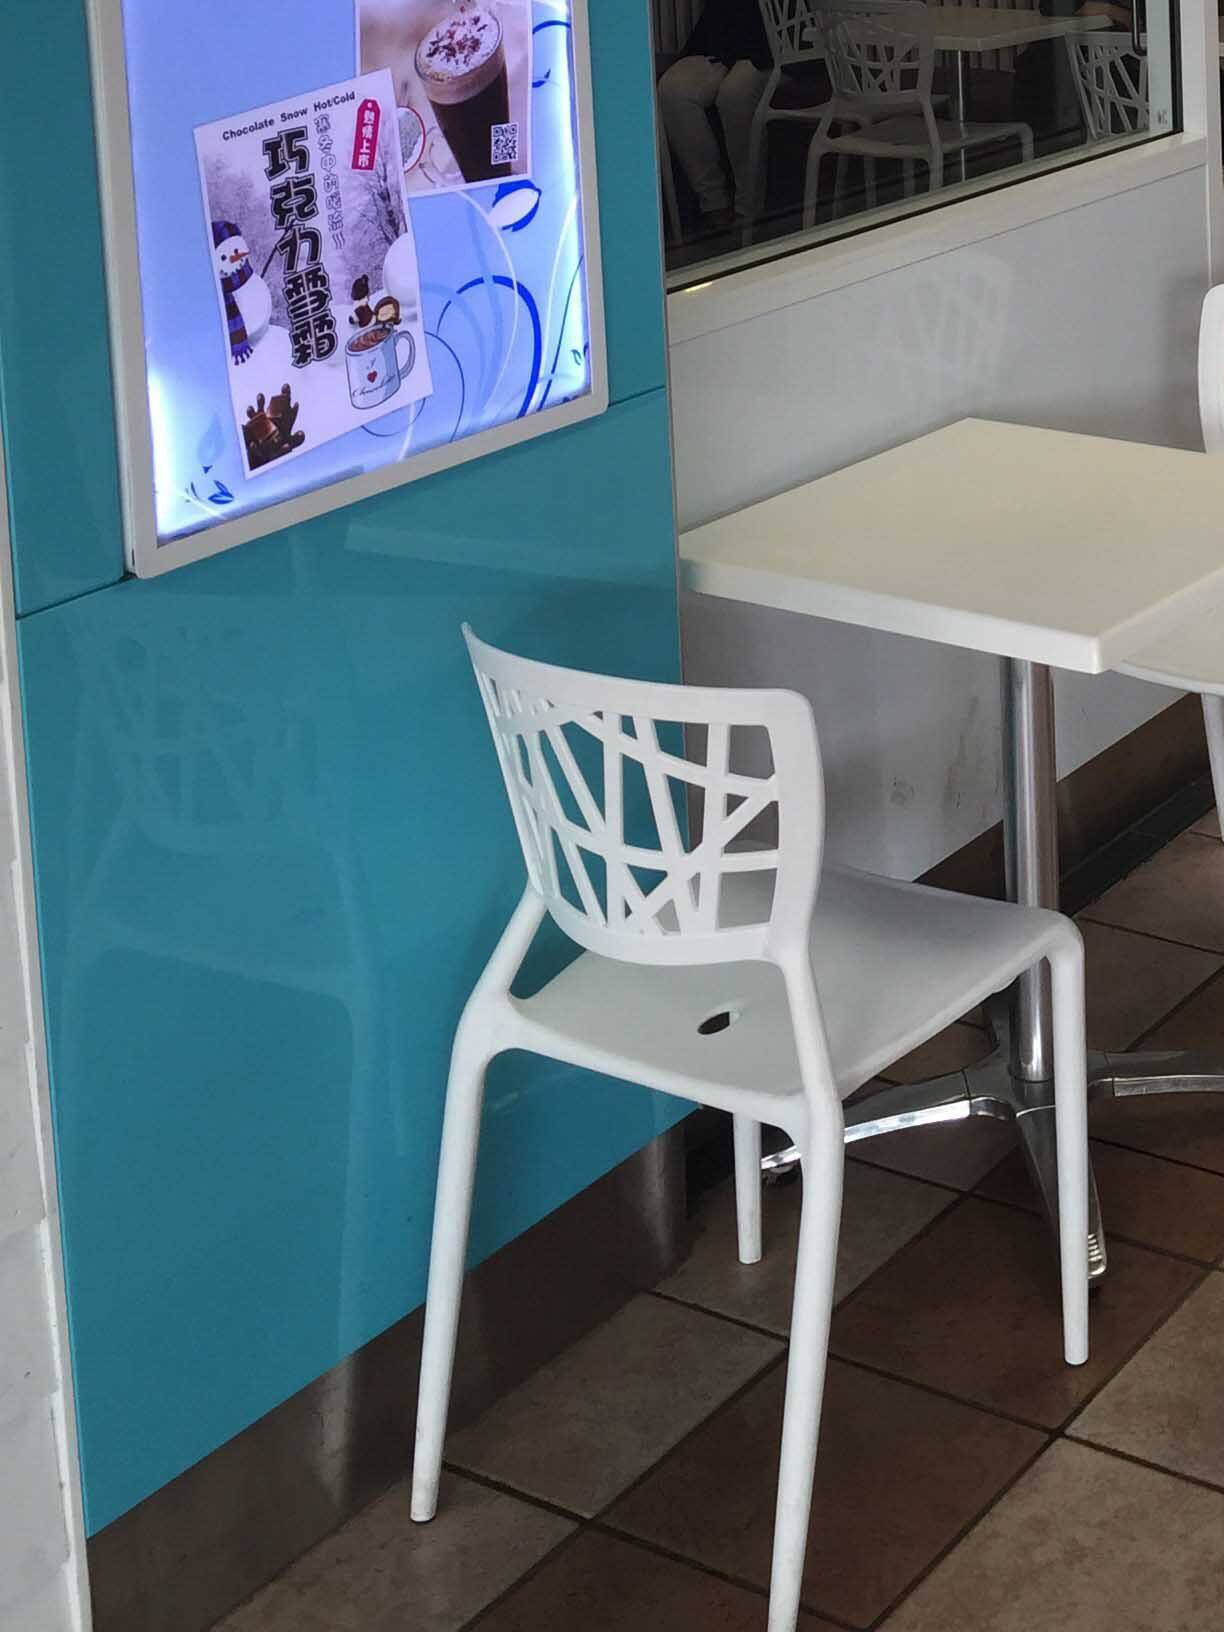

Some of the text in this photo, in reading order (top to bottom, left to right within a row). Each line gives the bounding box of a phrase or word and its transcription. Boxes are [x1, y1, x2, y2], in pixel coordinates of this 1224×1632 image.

[222, 91, 356, 142] Chocolate Snow Hot/Cold
